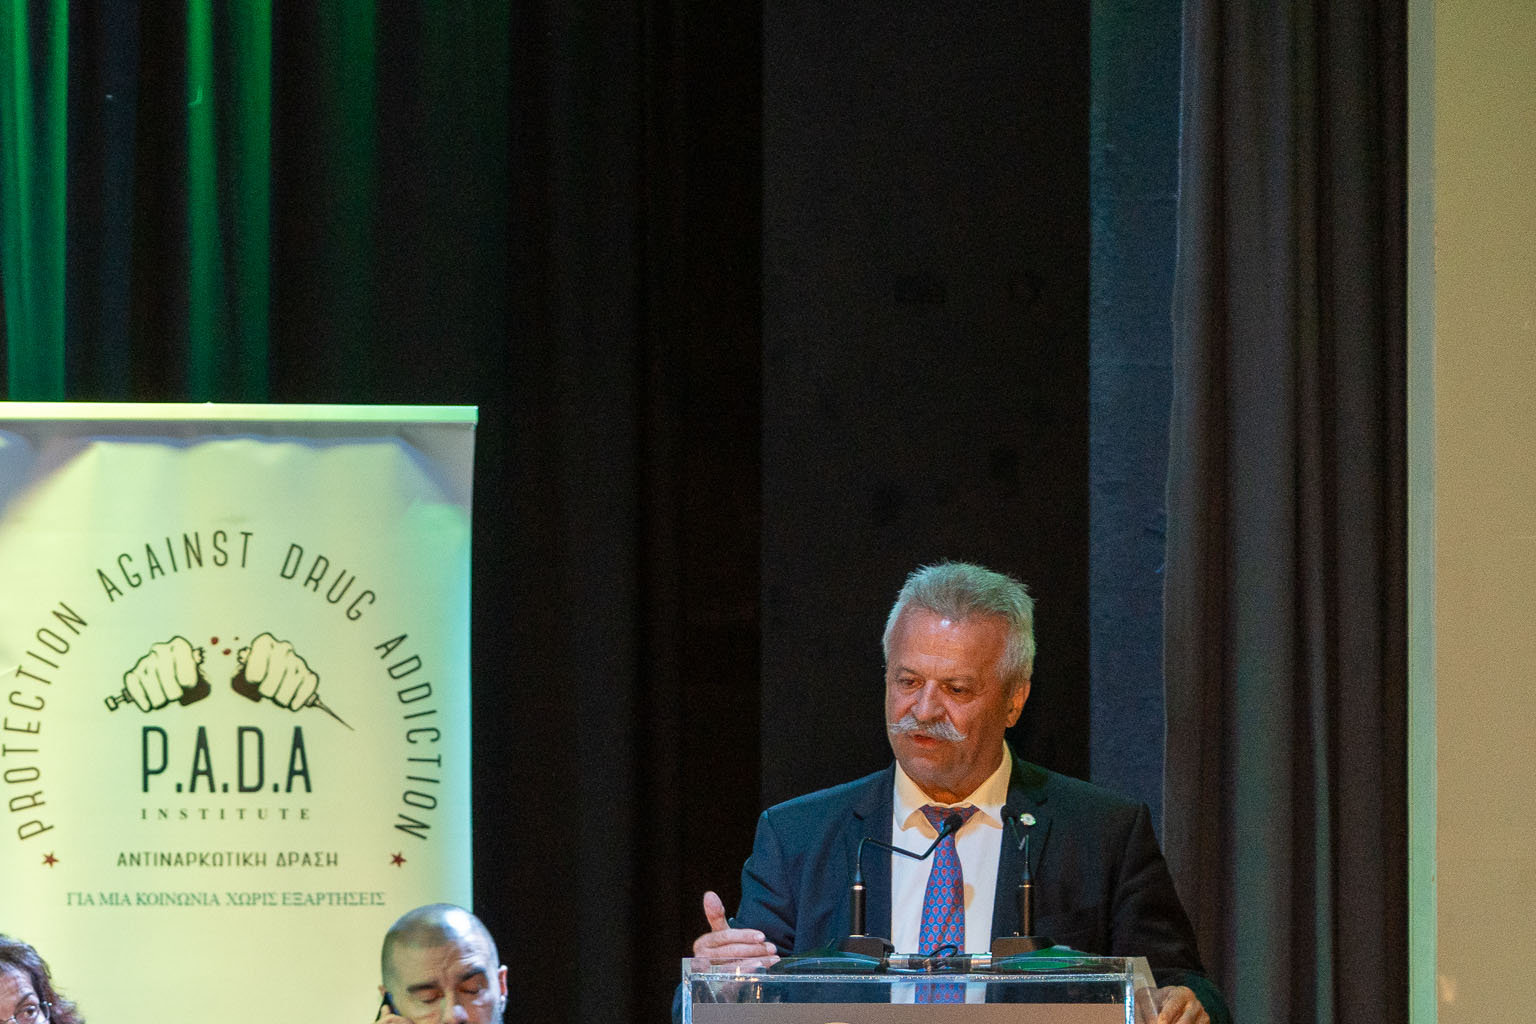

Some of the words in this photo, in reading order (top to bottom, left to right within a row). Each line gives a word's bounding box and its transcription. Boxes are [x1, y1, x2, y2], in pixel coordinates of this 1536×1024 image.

[1, 601, 88, 841] PROTECTION
[96, 530, 254, 602] AGAINST
[279, 543, 377, 622] DRUG
[374, 634, 442, 840] ADDICTION
[141, 725, 312, 793] P.A.D.A
[140, 808, 310, 820] INSTITUTE
[116, 851, 267, 867] ΑΝΤΙΝΑΡΚΩΤΙΚΗ
[275, 851, 339, 867] ΔΡΑΣΗ
[66, 891, 95, 907] ΓΙΑ
[98, 891, 132, 907] ΜΙΑ
[135, 891, 221, 907] ΚΟΙΝΩΝΙΑ
[226, 891, 278, 907] ΧΩΡΙΣ
[281, 891, 386, 907] ΕΞΑΡΤΗΣΕΙΣ
